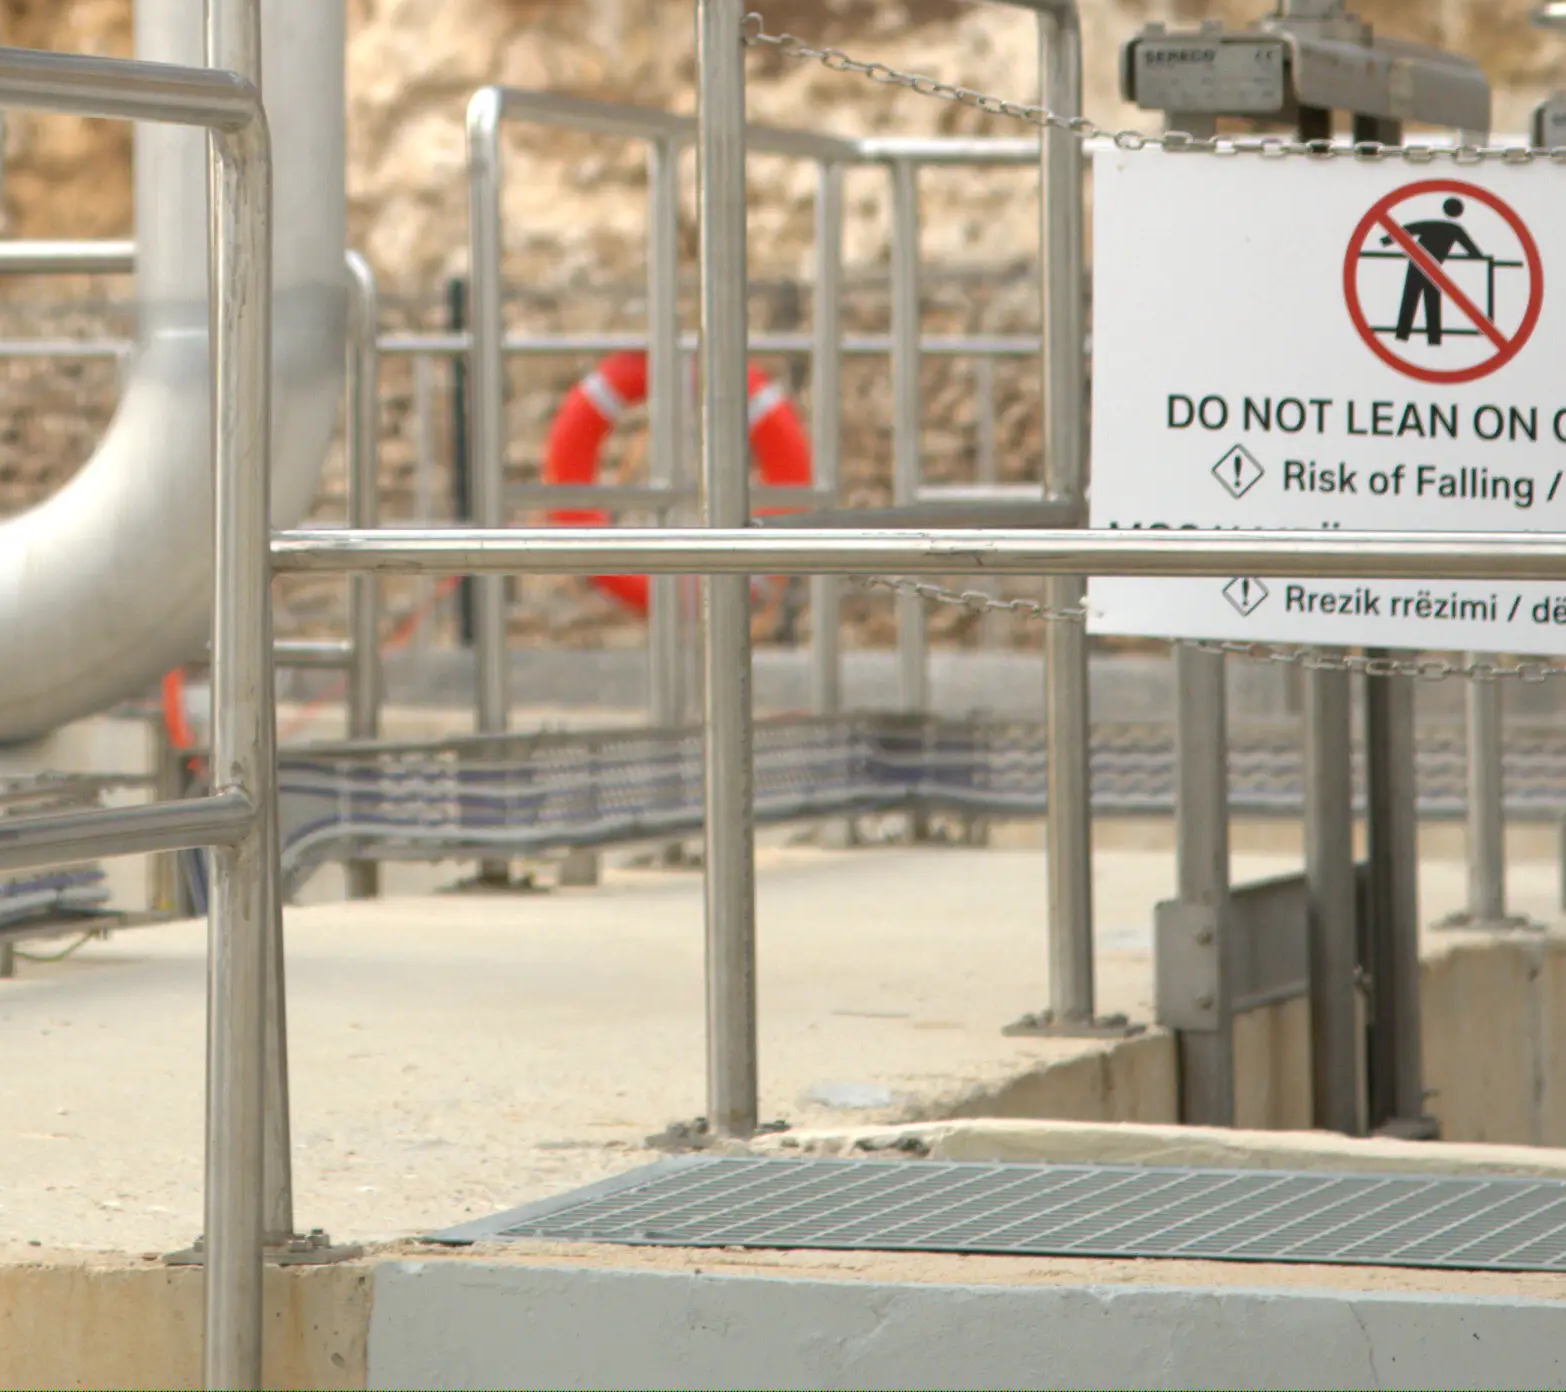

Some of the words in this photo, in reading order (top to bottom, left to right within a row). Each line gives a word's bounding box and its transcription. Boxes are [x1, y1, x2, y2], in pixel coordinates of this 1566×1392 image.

[1166, 393, 1229, 431] DO
[1243, 396, 1334, 434] NOT
[1346, 399, 1458, 440] LEAN
[1473, 403, 1538, 442] ON
[1283, 459, 1358, 494] Risk
[1369, 463, 1406, 496] of
[1417, 465, 1535, 509] Falling
[1546, 469, 1564, 503] /
[1284, 584, 1381, 617] Rrezik
[1389, 589, 1498, 622] rrëzimi
[1506, 594, 1523, 623] /
